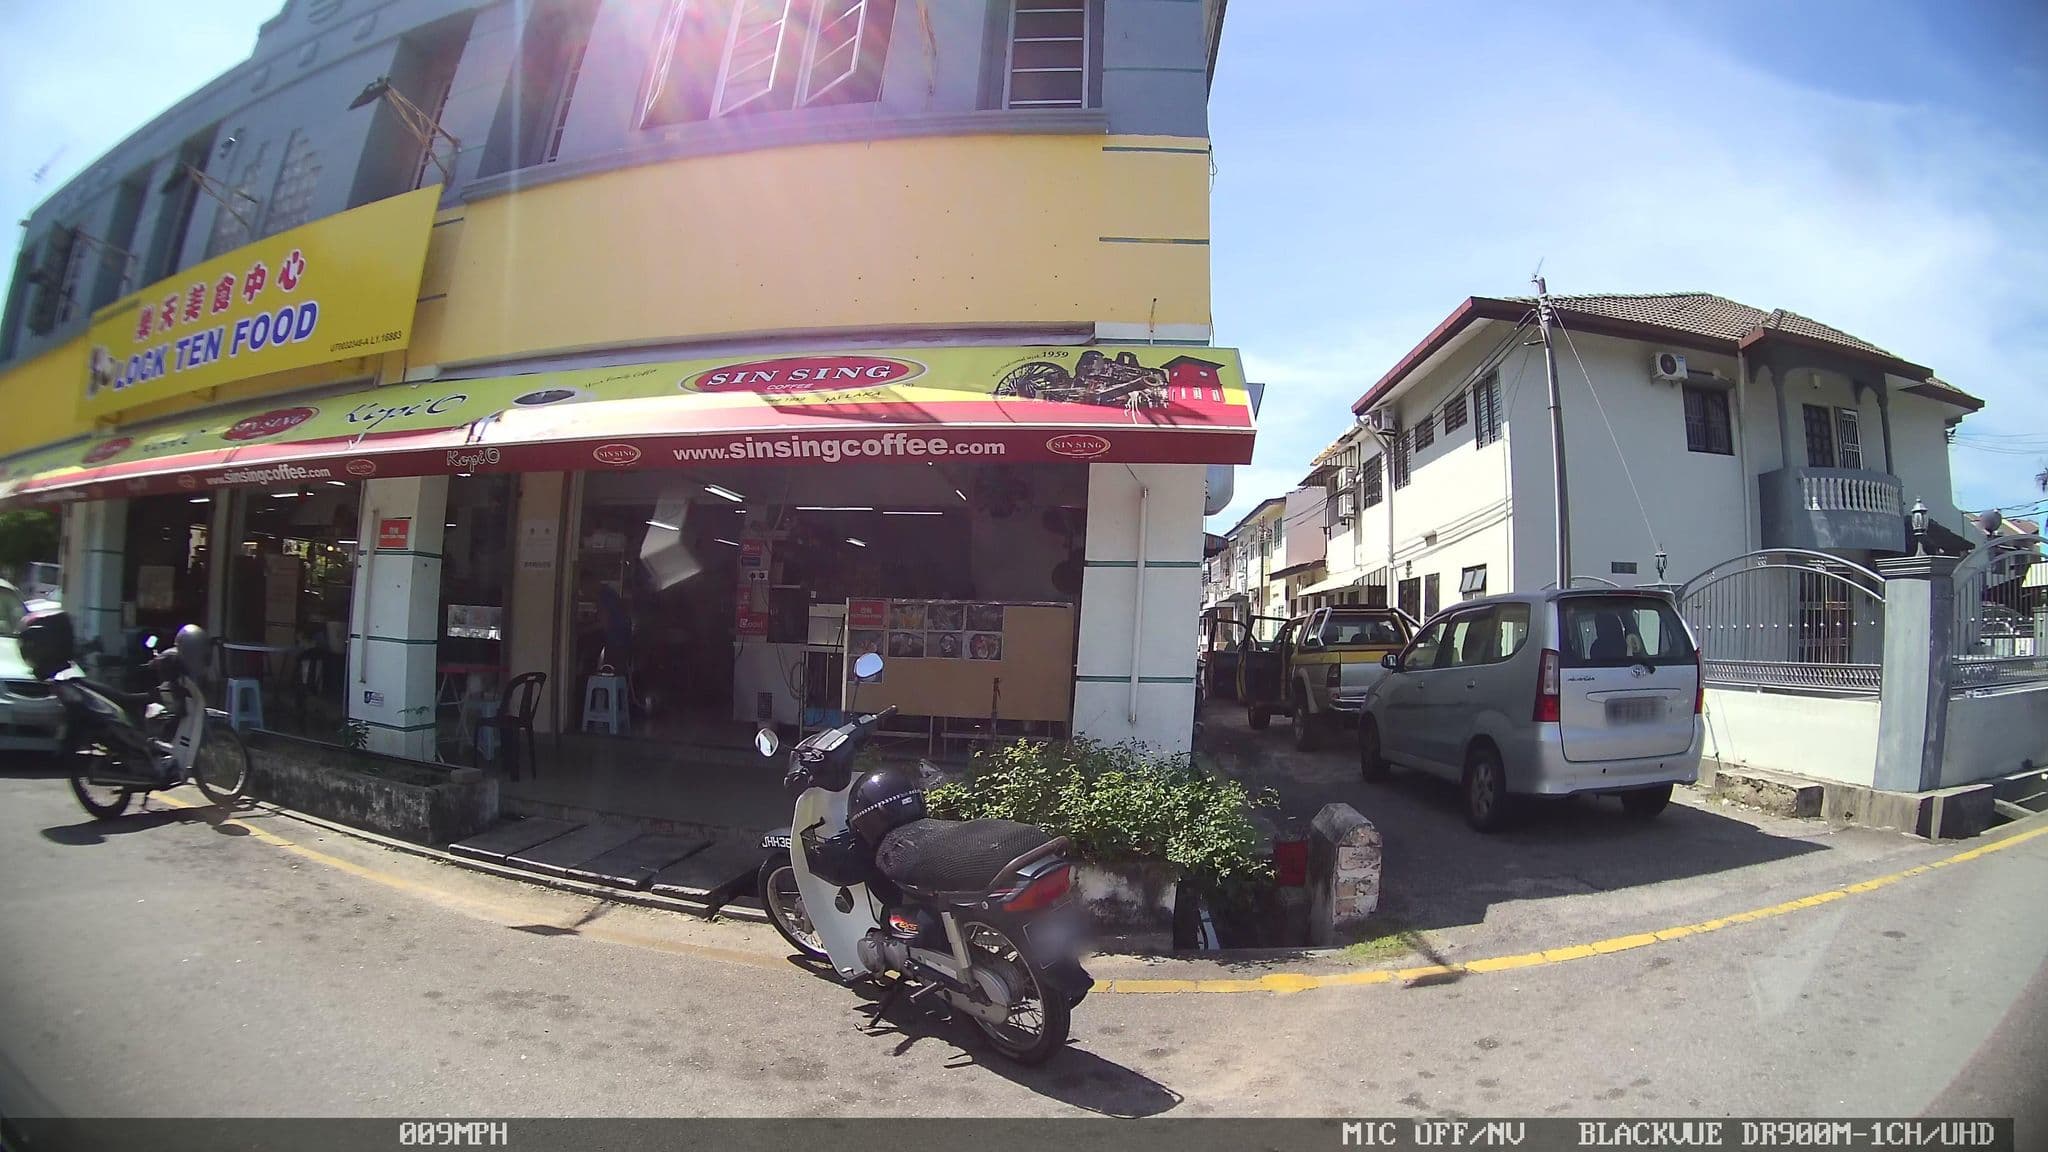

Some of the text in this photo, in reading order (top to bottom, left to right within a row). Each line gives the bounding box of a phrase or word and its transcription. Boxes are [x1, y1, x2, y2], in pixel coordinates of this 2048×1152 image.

[175, 327, 224, 371] TEN
[230, 301, 319, 356] FOOD
[706, 364, 892, 386] SIN SING
[673, 433, 1006, 463] www.sinsingcoffee.com
